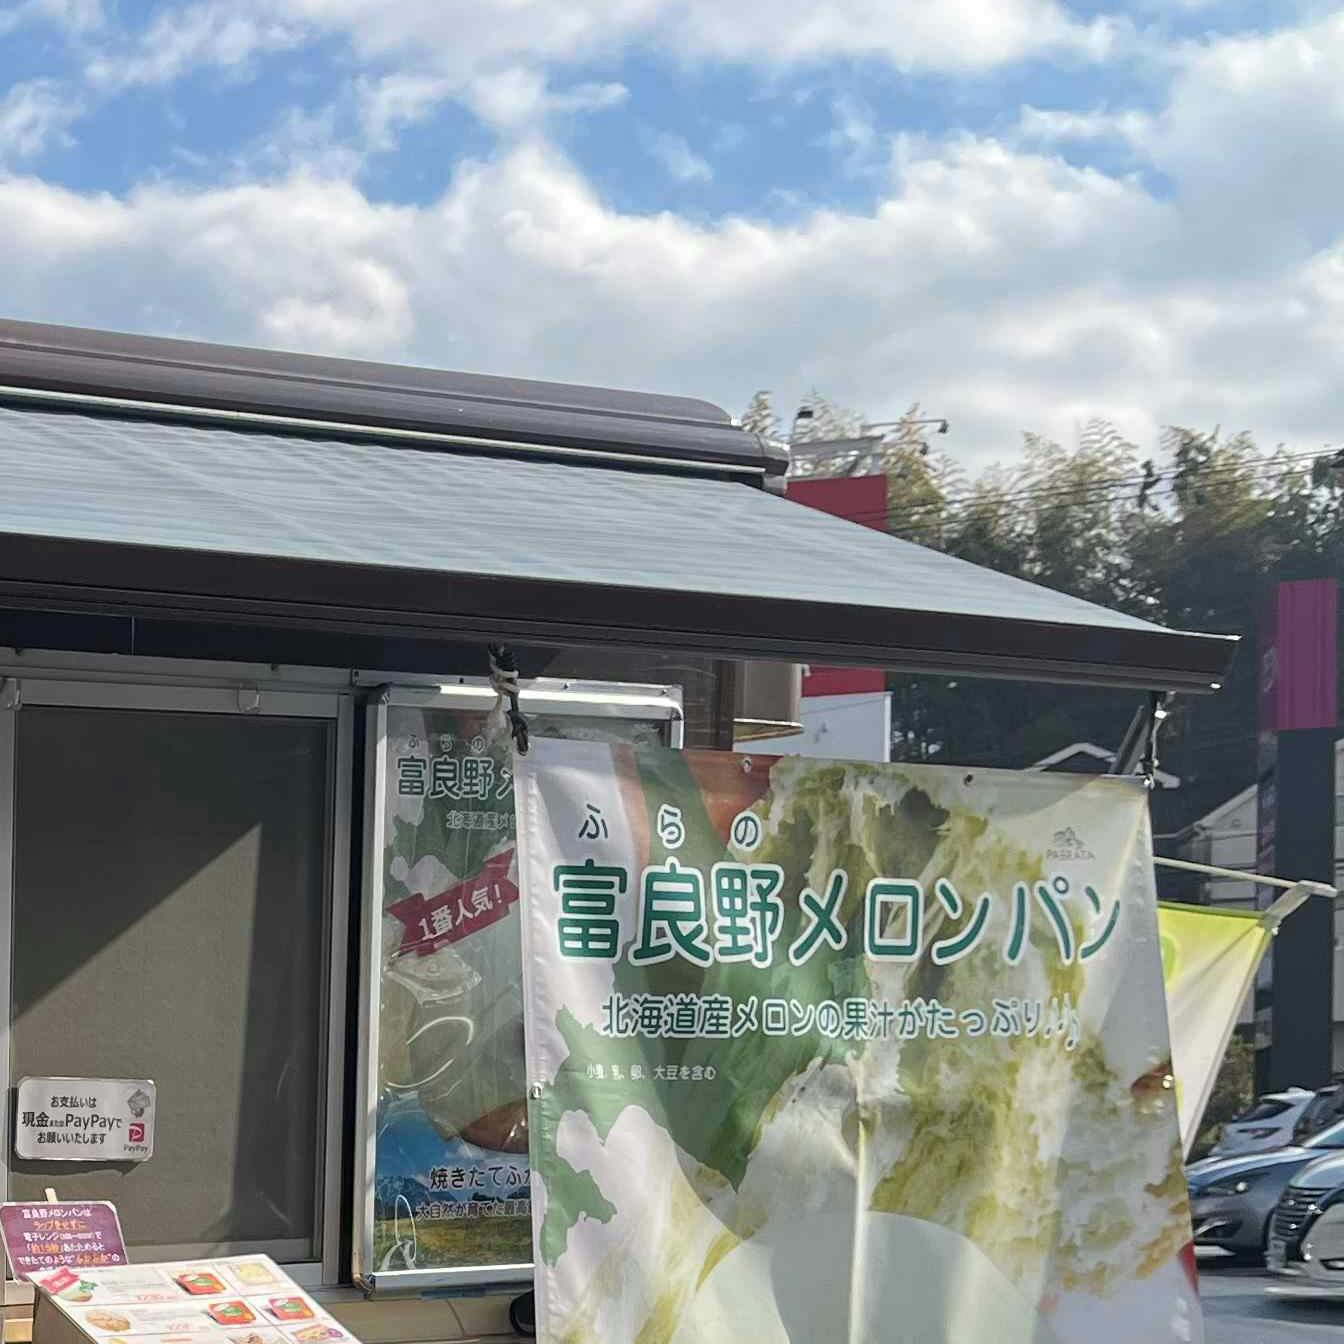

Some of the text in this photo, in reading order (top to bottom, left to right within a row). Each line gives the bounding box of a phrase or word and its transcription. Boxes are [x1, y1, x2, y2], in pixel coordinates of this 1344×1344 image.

[551, 856, 1122, 967] 富良野メロンパン
